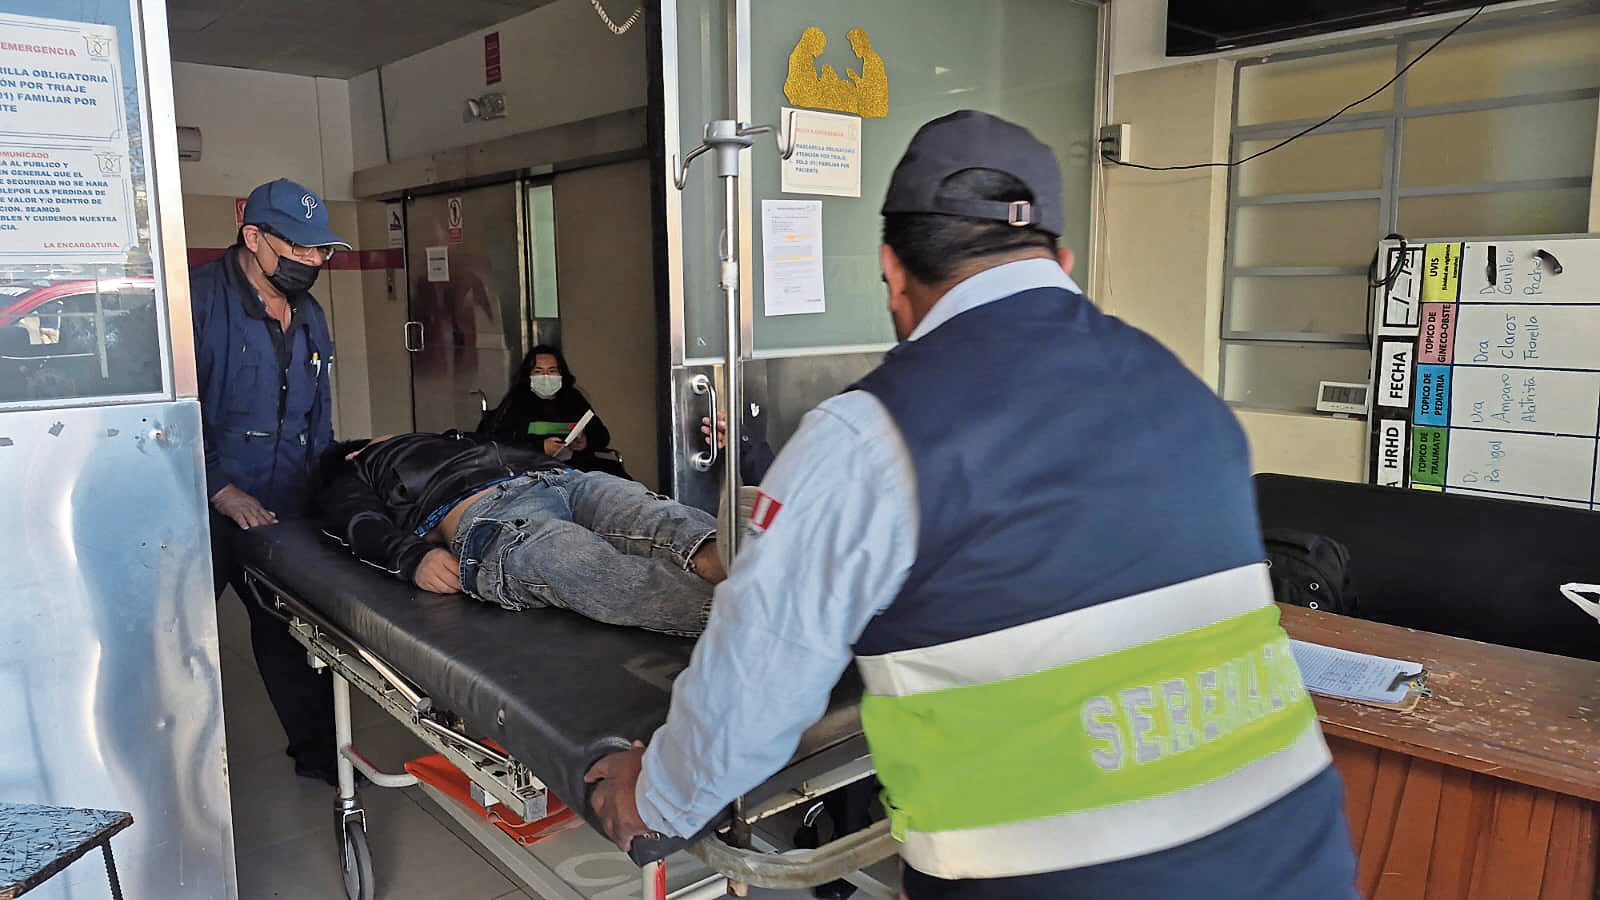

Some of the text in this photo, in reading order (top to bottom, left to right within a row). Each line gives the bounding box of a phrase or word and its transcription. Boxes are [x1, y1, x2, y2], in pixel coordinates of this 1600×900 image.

[0, 41, 77, 57] EMERGENCIA
[20, 81, 43, 90] POR
[47, 83, 87, 94] TRIAJE
[32, 70, 109, 84] OBLIGATORIA
[17, 93, 71, 105] FAMILIAR
[74, 97, 97, 106] POR
[11, 169, 51, 177] GENERAL
[33, 215, 78, 223] CUIDEMOS
[79, 215, 118, 223] NUESTRA
[301, 193, 318, 219] P
[1429, 257, 1440, 277] UVIS
[1424, 311, 1437, 355] TOPICO DE
[1437, 304, 1451, 363] GINECO-OBSTE
[1473, 340, 1489, 363] Dra
[1389, 351, 1407, 399] FECHA
[1420, 373, 1431, 416] TOPICO DE
[1434, 374, 1445, 416] PEDIATRIA
[1384, 426, 1399, 469] HRHD
[1418, 431, 1429, 473] TOPICO DE
[1431, 431, 1441, 475] TRAUMATO
